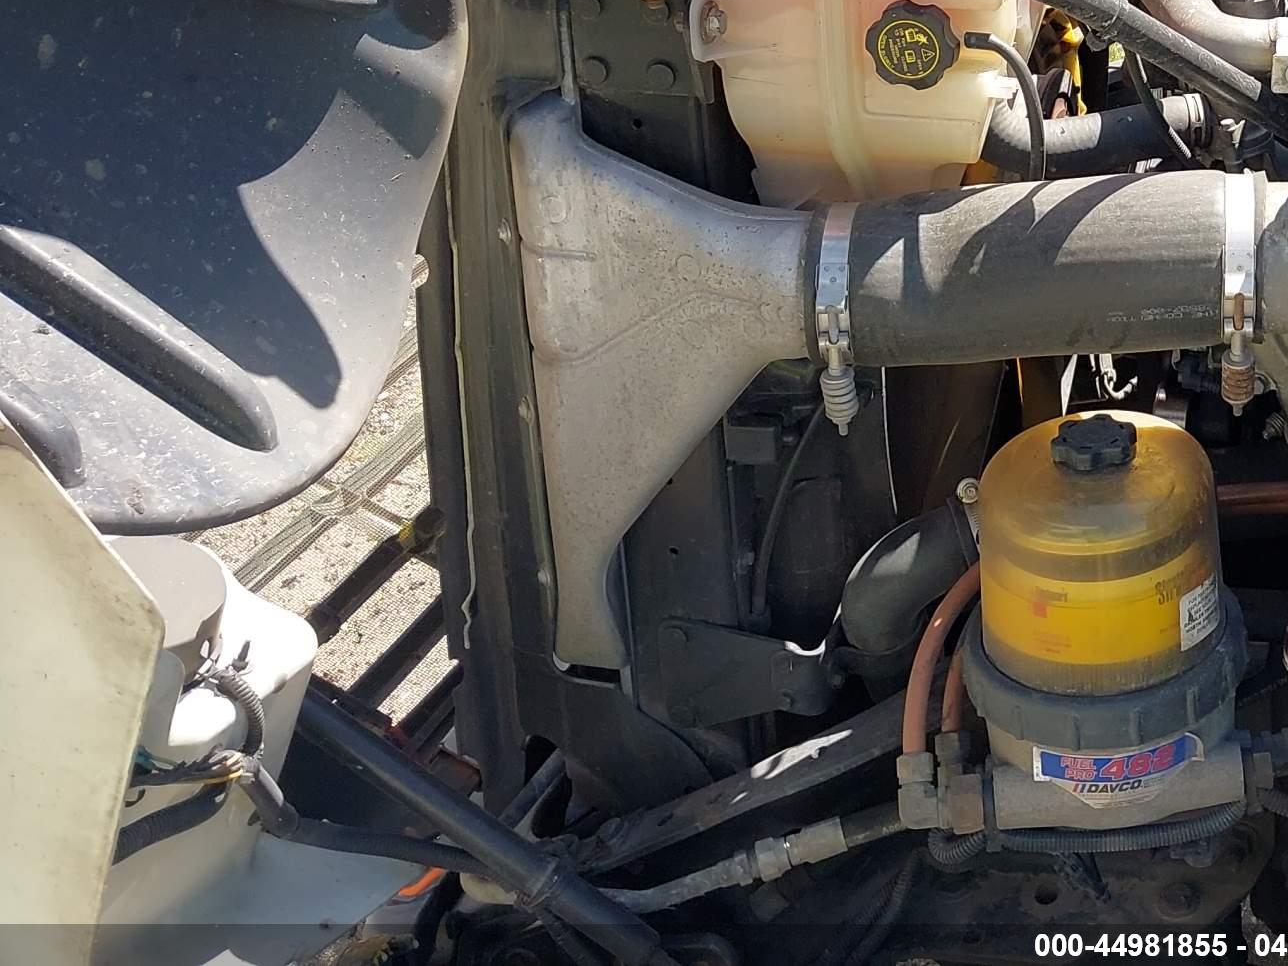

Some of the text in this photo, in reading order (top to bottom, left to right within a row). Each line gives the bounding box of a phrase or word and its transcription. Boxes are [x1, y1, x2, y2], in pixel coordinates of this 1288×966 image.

[1060, 756, 1096, 770] FUEL
[1100, 745, 1176, 781] 482
[1065, 768, 1095, 781] PRO
[1086, 778, 1142, 794] DAVCO
